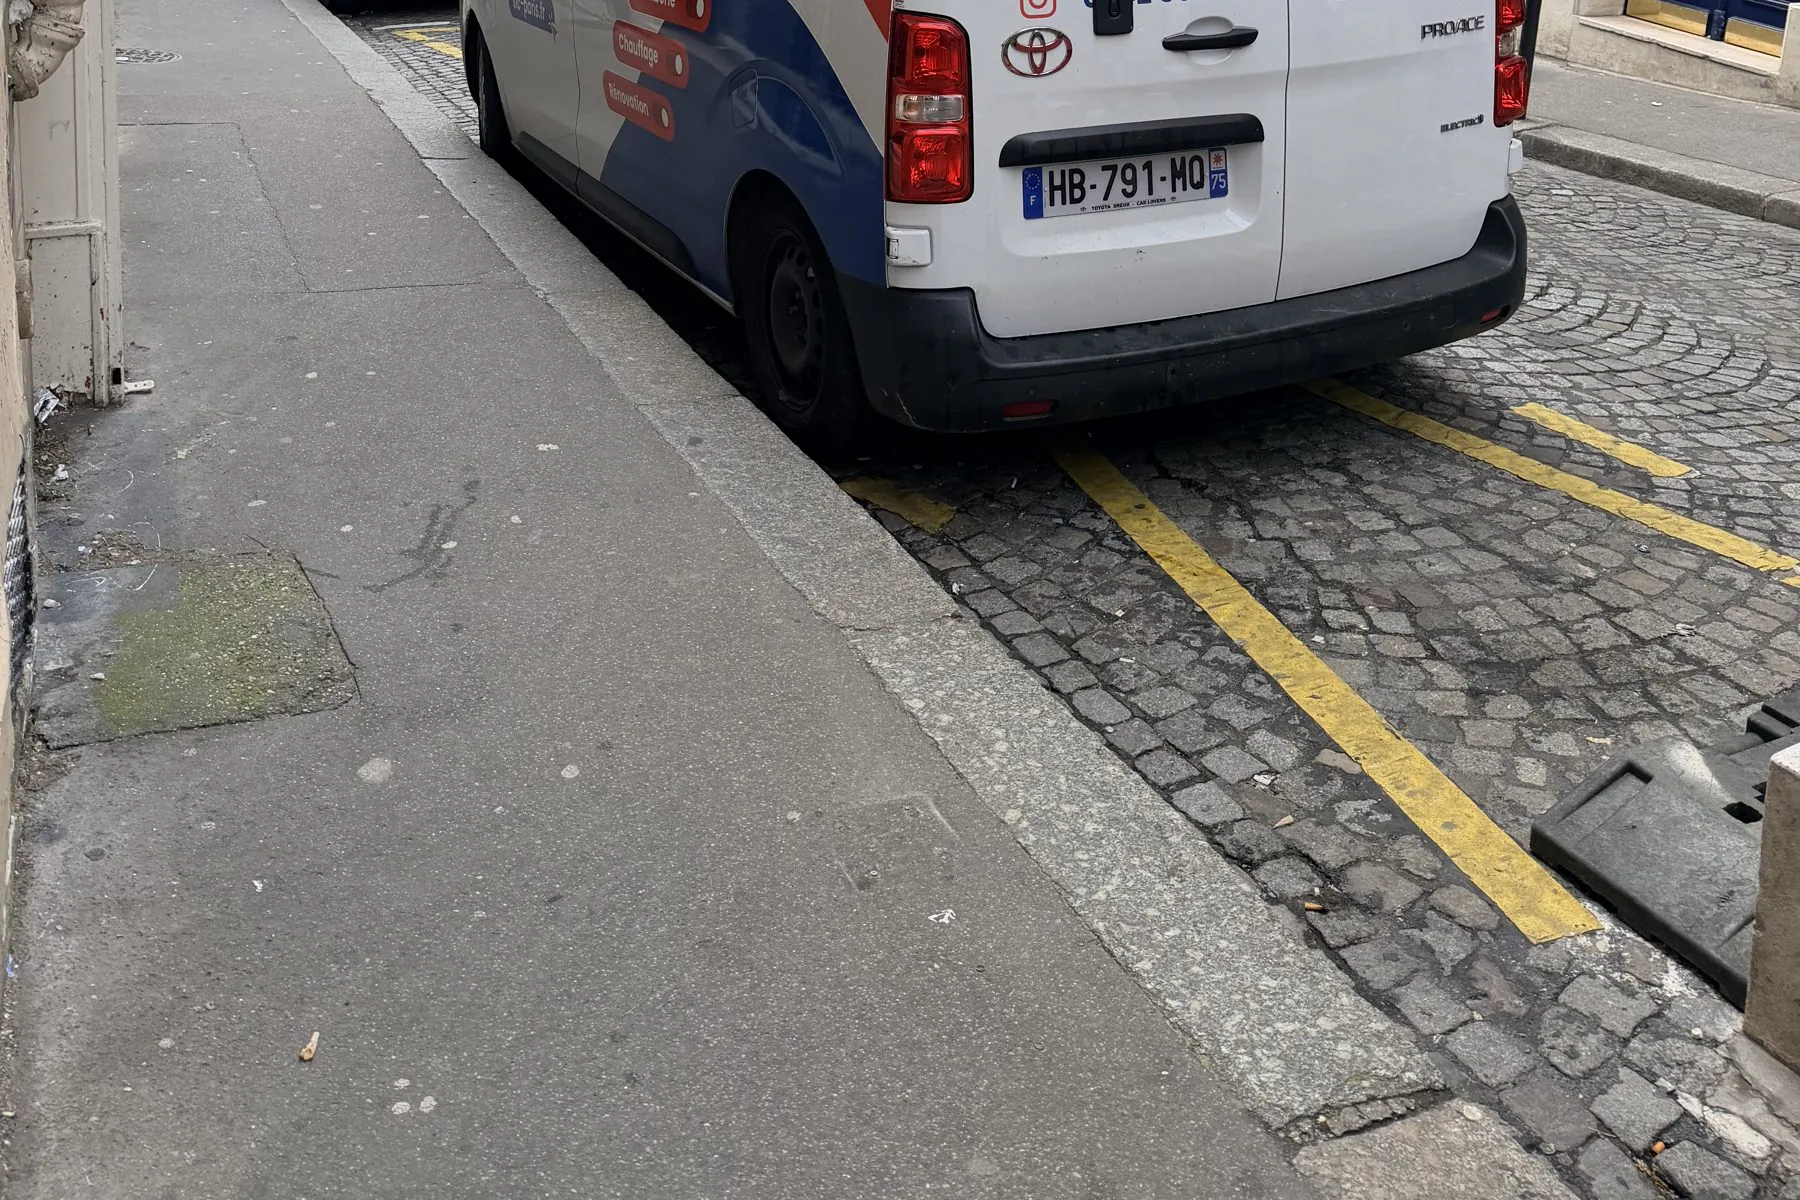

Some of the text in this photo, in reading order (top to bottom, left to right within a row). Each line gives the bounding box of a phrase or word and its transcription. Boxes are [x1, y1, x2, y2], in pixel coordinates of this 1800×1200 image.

[1421, 15, 1485, 40] PROACE
[618, 33, 659, 68] Chauffage
[608, 82, 650, 117] Rénovation
[1048, 154, 1205, 206] HB-791-MQ
[1211, 172, 1227, 191] 75
[1030, 195, 1036, 206] F
